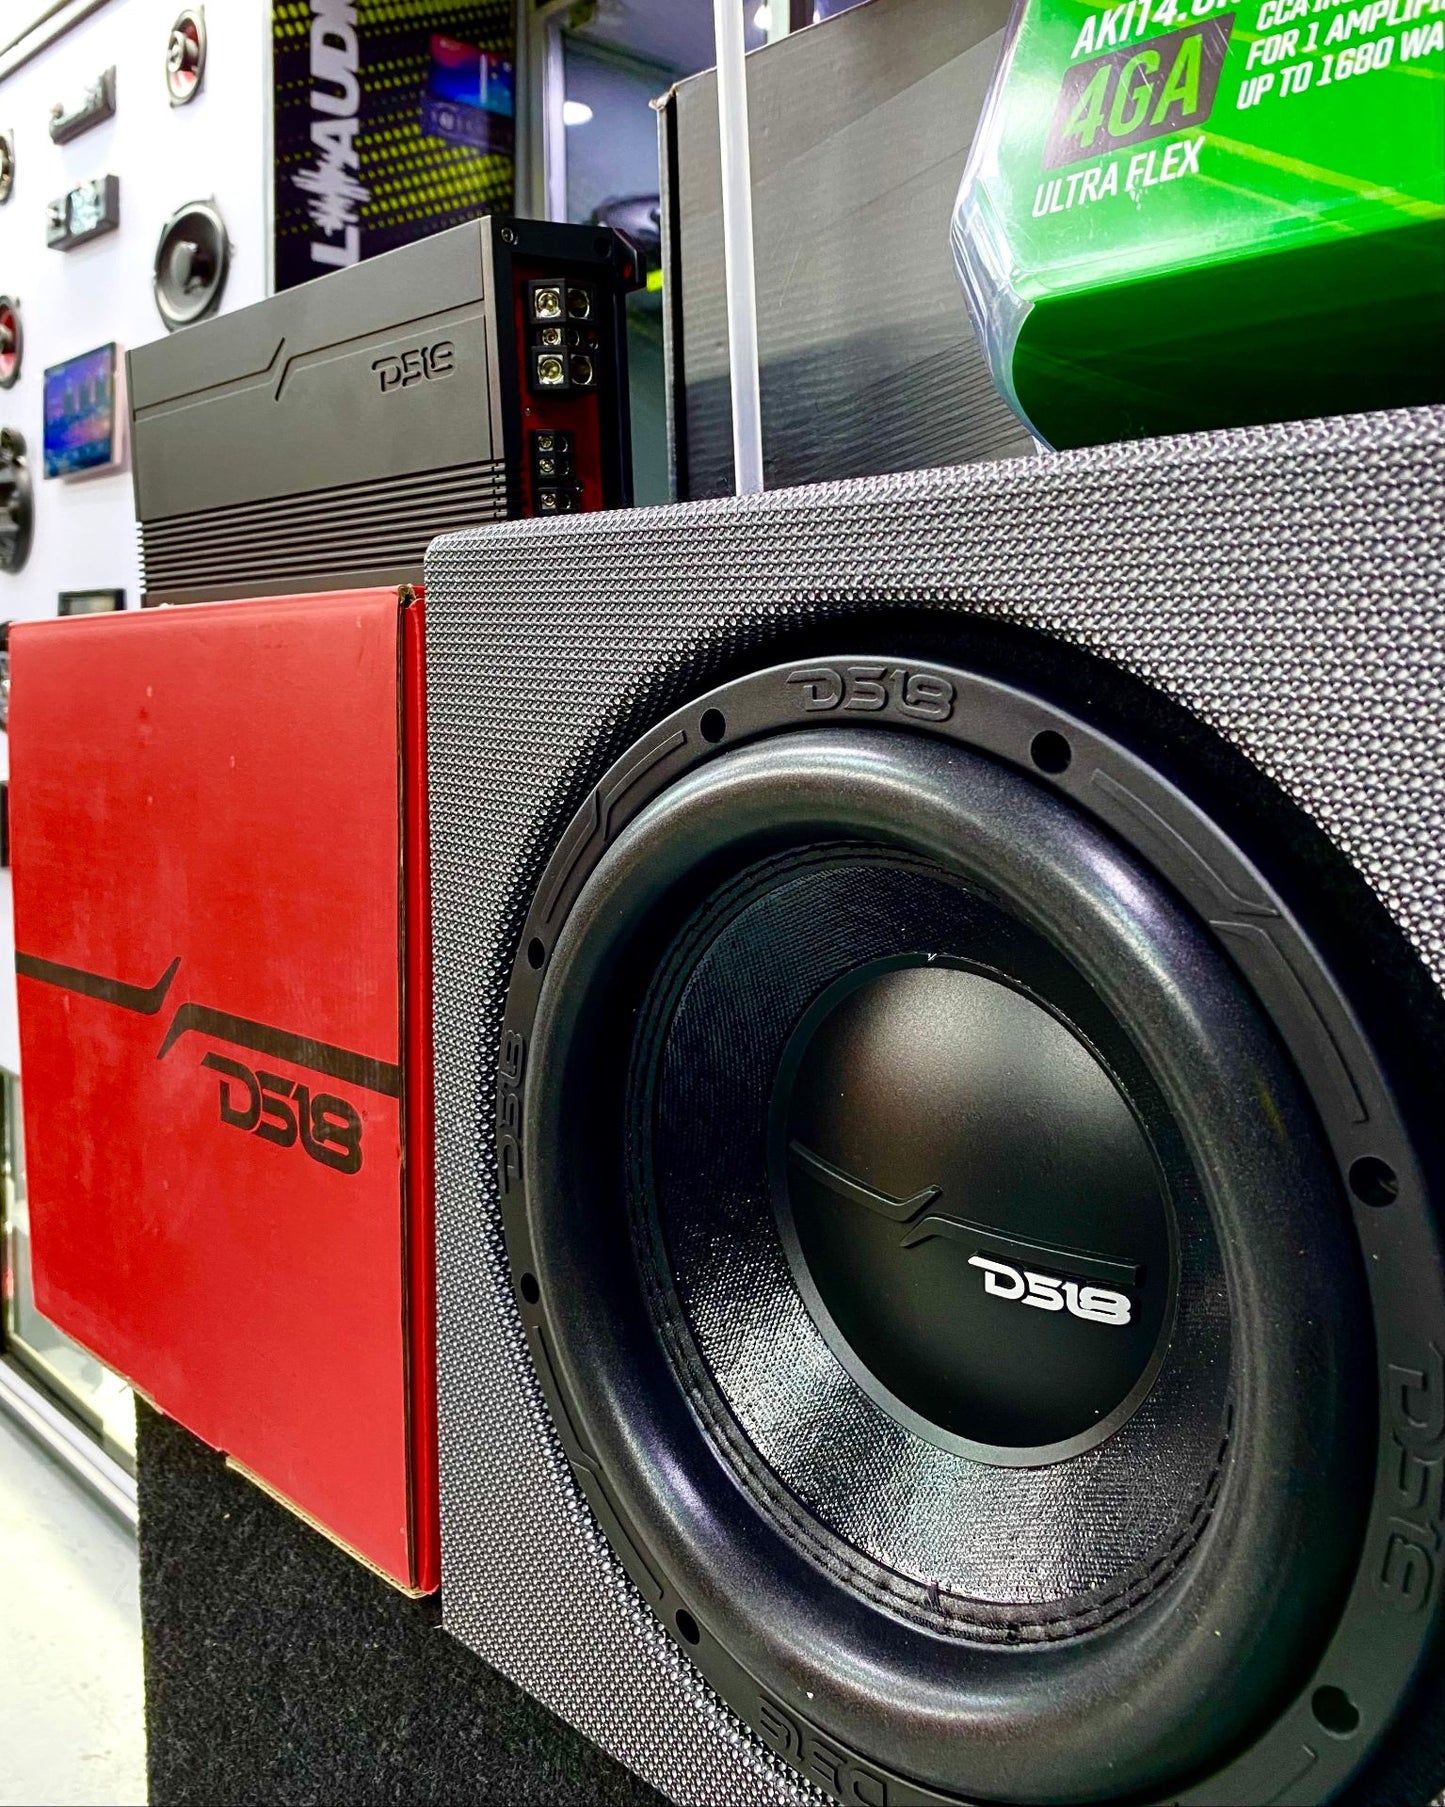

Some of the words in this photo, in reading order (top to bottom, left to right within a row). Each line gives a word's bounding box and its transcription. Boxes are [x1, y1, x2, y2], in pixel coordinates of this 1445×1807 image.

[1236, 73, 1275, 110] UP
[1279, 61, 1314, 97] TO
[1316, 36, 1395, 86] 1680
[1245, 28, 1300, 71] FOR
[1302, 22, 1319, 53] 1
[1060, 33, 1203, 148] 4GA
[1032, 161, 1118, 218] ULTRA
[1124, 135, 1206, 192] FLEX
[785, 666, 957, 722] DS18
[201, 1052, 363, 1174] DS18
[967, 1255, 1132, 1326] DS18
